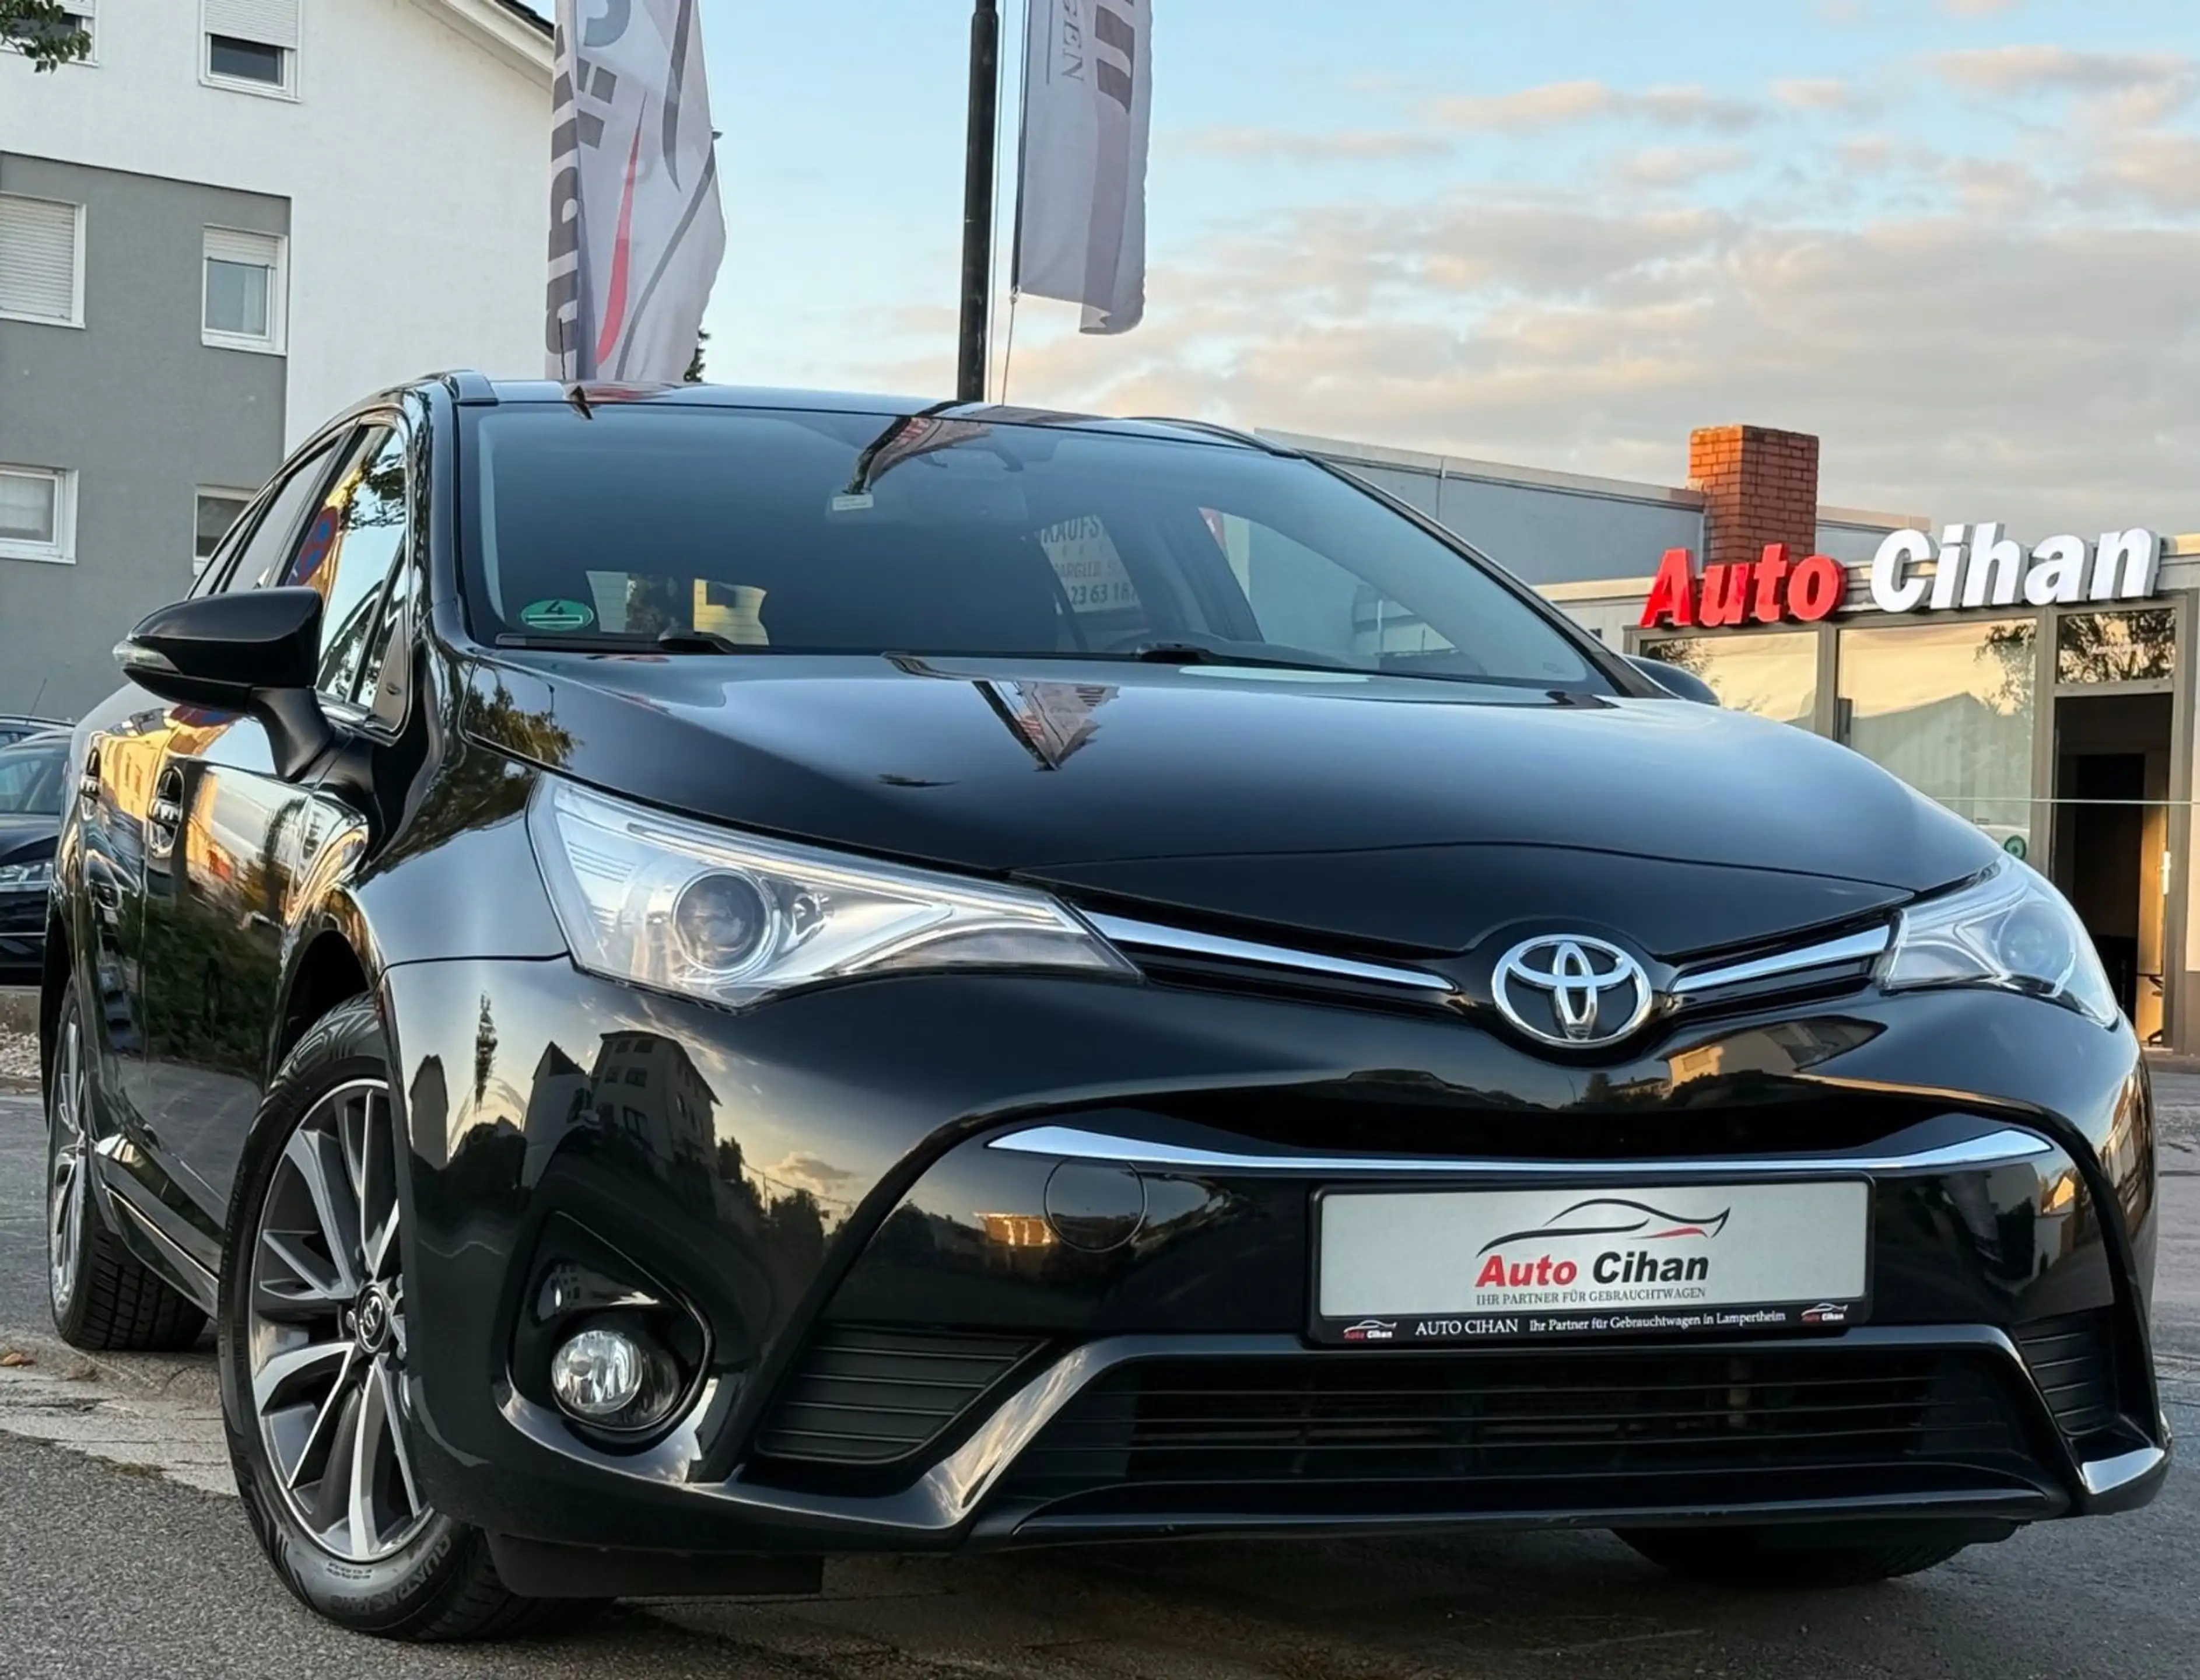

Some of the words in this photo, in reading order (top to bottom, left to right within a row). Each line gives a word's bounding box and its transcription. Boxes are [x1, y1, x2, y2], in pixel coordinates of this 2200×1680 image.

[1640, 542, 1847, 629] Auto
[1869, 522, 2162, 614] Cihan
[544, 600, 565, 615] 4
[1476, 1254, 1578, 1288] Auto
[1593, 1251, 1709, 1284] Cihan
[1476, 1293, 1500, 1306] IHR
[1502, 1290, 1559, 1305] PARTNER
[1563, 1288, 1586, 1303] FÜR
[1589, 1287, 1706, 1301] GEBRAUCHTWAGEN
[1415, 1321, 1462, 1336] AUTO
[1465, 1318, 1519, 1334] CIHAN
[1529, 1320, 1546, 1332] Ihr
[1549, 1318, 1589, 1331] Partner
[1591, 1317, 1608, 1329] für
[1610, 1314, 1701, 1330] Gebrauchtwagen
[1703, 1314, 1714, 1325] in
[1716, 1311, 1786, 1328] Lampertheim
